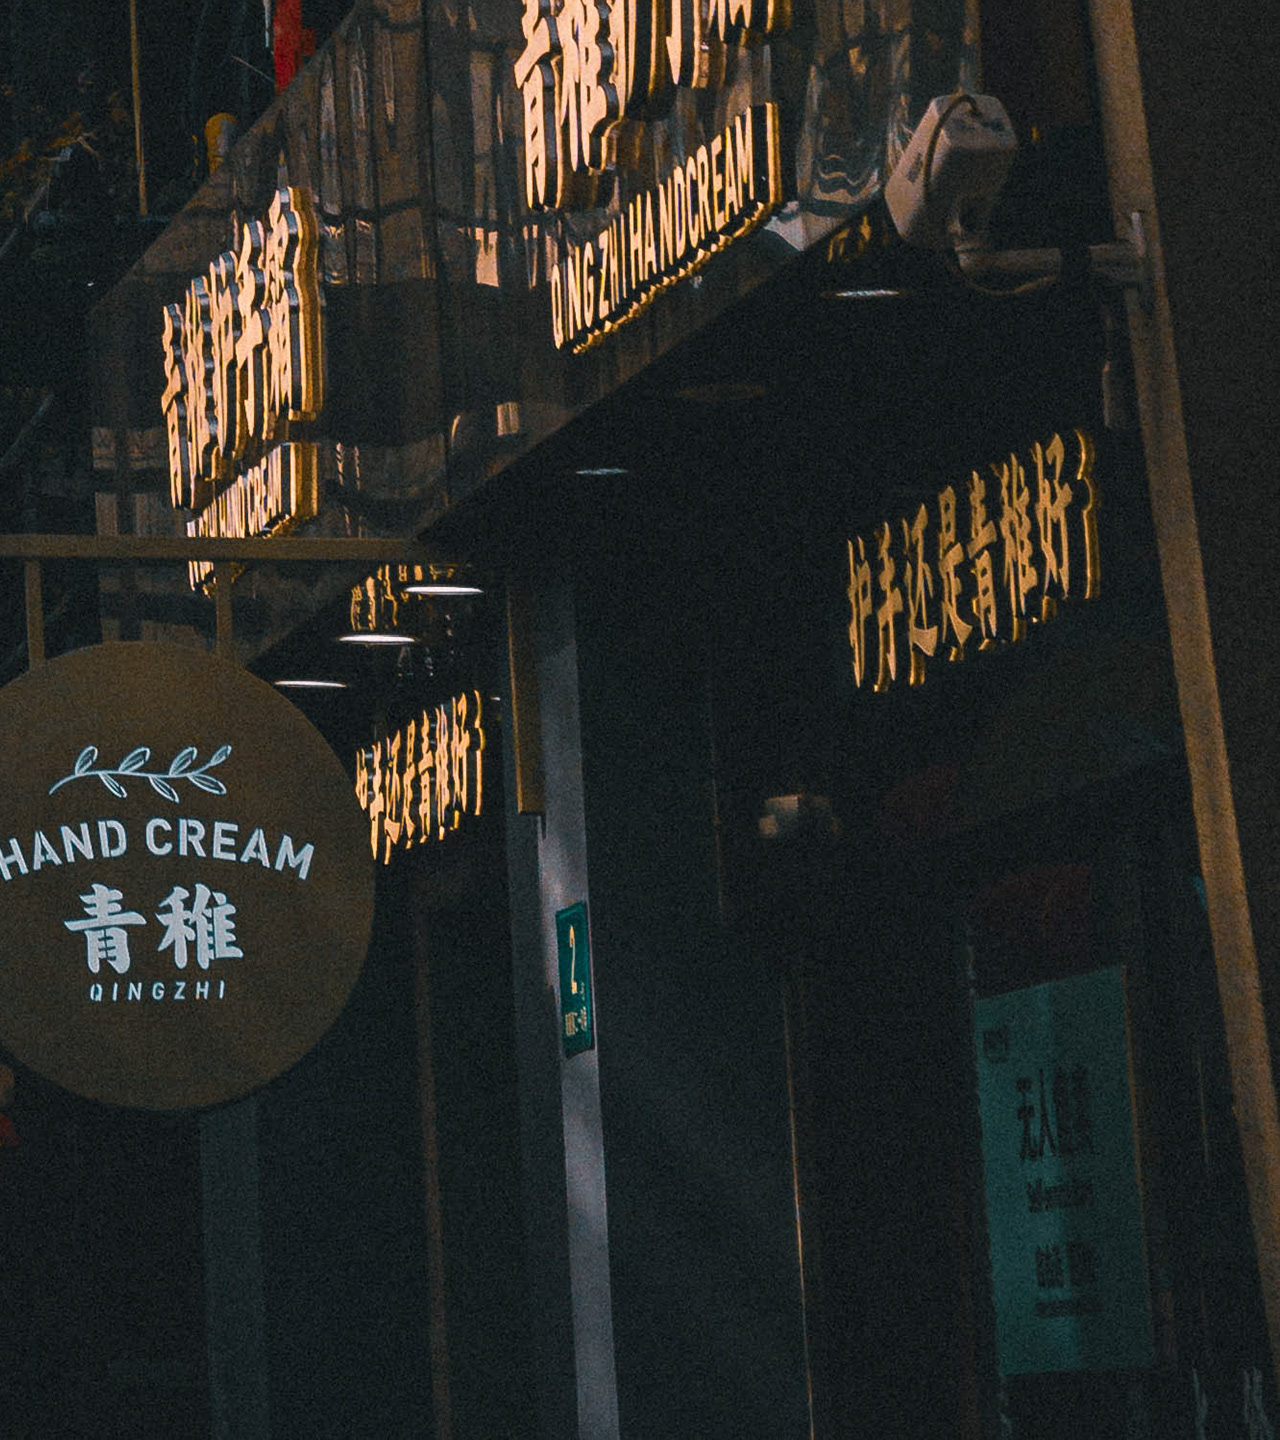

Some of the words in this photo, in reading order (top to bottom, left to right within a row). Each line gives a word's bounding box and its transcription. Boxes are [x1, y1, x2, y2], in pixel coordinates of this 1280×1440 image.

[161, 187, 295, 510] 青稚护手霜
[847, 432, 1074, 689] 护手还是青稚好
[144, 815, 316, 882] CREAM
[63, 882, 245, 976] 青稚
[568, 924, 579, 996] 2
[89, 981, 228, 1003] QINGZHI
